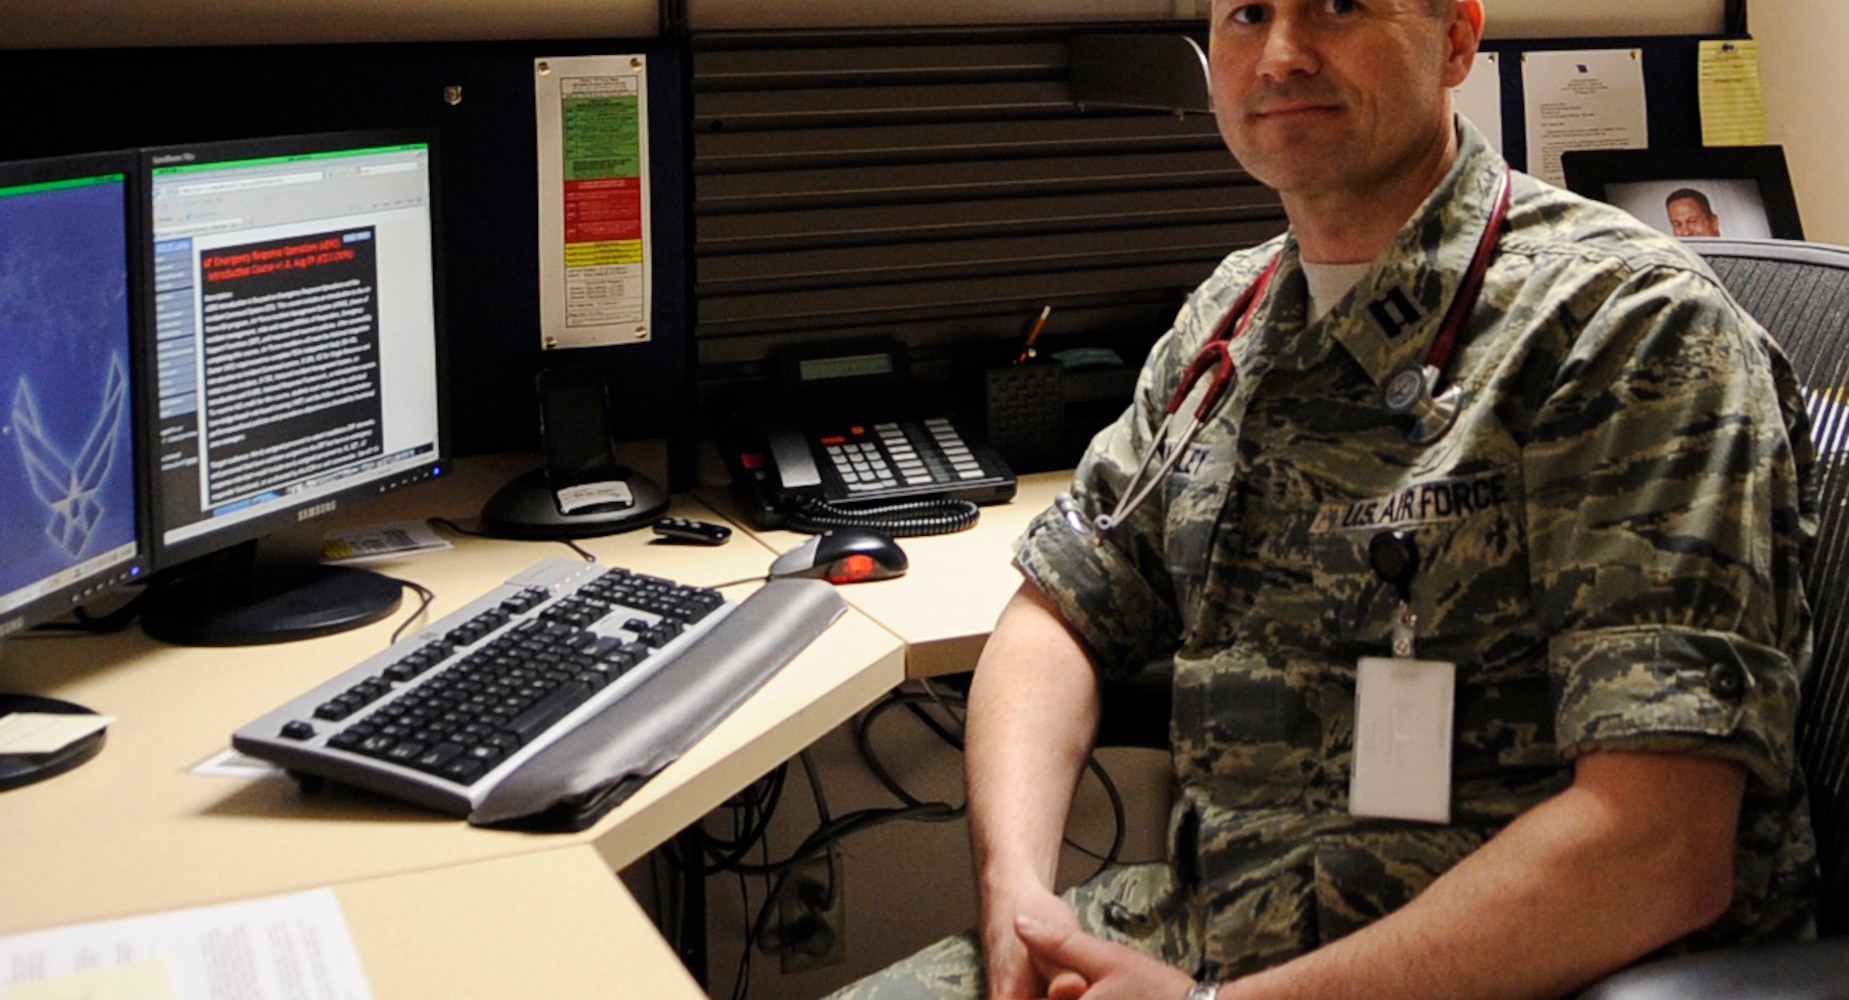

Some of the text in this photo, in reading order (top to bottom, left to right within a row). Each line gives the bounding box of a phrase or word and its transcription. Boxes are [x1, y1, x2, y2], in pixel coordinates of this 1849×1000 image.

[298, 499, 337, 522] SAMSUNG
[1378, 491, 1415, 523] AIR
[1421, 473, 1508, 518] FORCE
